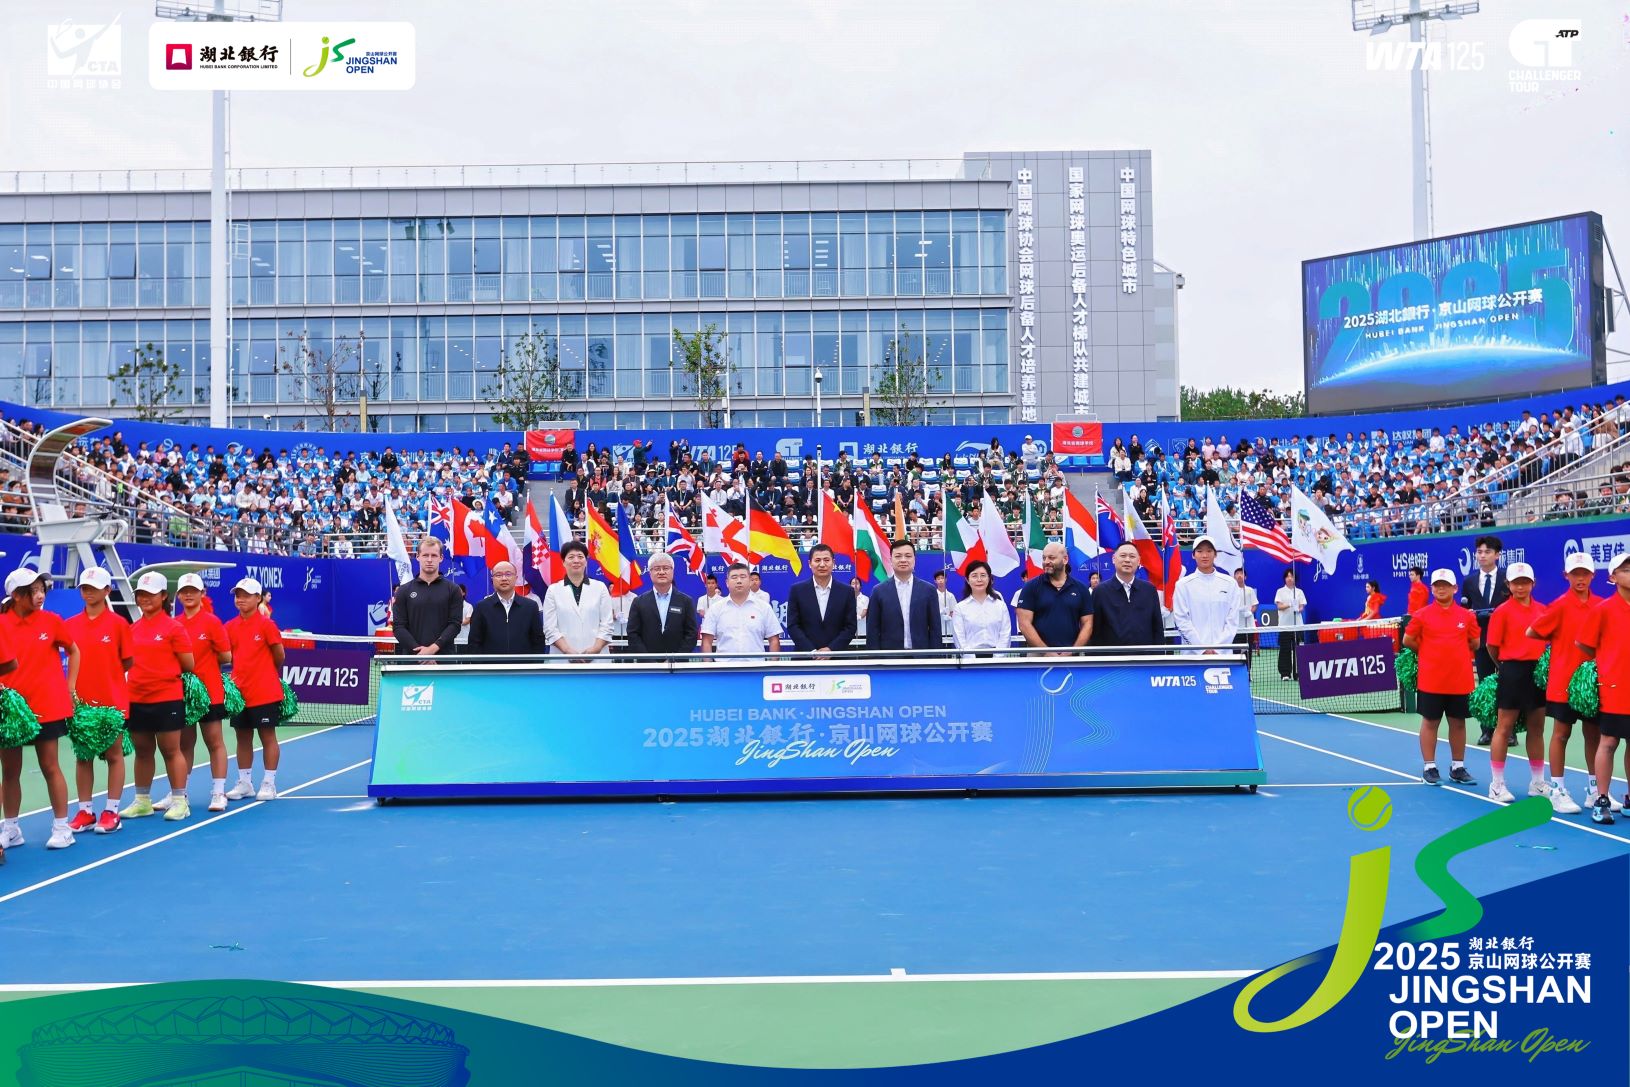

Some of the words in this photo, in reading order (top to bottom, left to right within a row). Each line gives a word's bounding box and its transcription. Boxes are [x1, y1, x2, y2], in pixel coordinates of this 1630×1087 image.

[1120, 167, 1138, 294] 中国网球特色城市
[1017, 168, 1037, 422] 中国网球协会网球后备人才培养基地
[1365, 329, 1394, 340] HUBEI
[1398, 325, 1425, 336] BANK
[1434, 317, 1486, 330] JINGSHAN
[1490, 312, 1519, 324] OPEN
[259, 566, 283, 588] YONEX
[283, 666, 331, 687] WTA
[334, 667, 359, 687] 125
[1150, 675, 1180, 687] WTA
[1181, 675, 1197, 687] 125
[1308, 657, 1359, 681] WTA
[1360, 654, 1386, 676] 125
[690, 708, 743, 722] HUBEI
[898, 705, 947, 719] OPEN
[843, 738, 900, 766] Open
